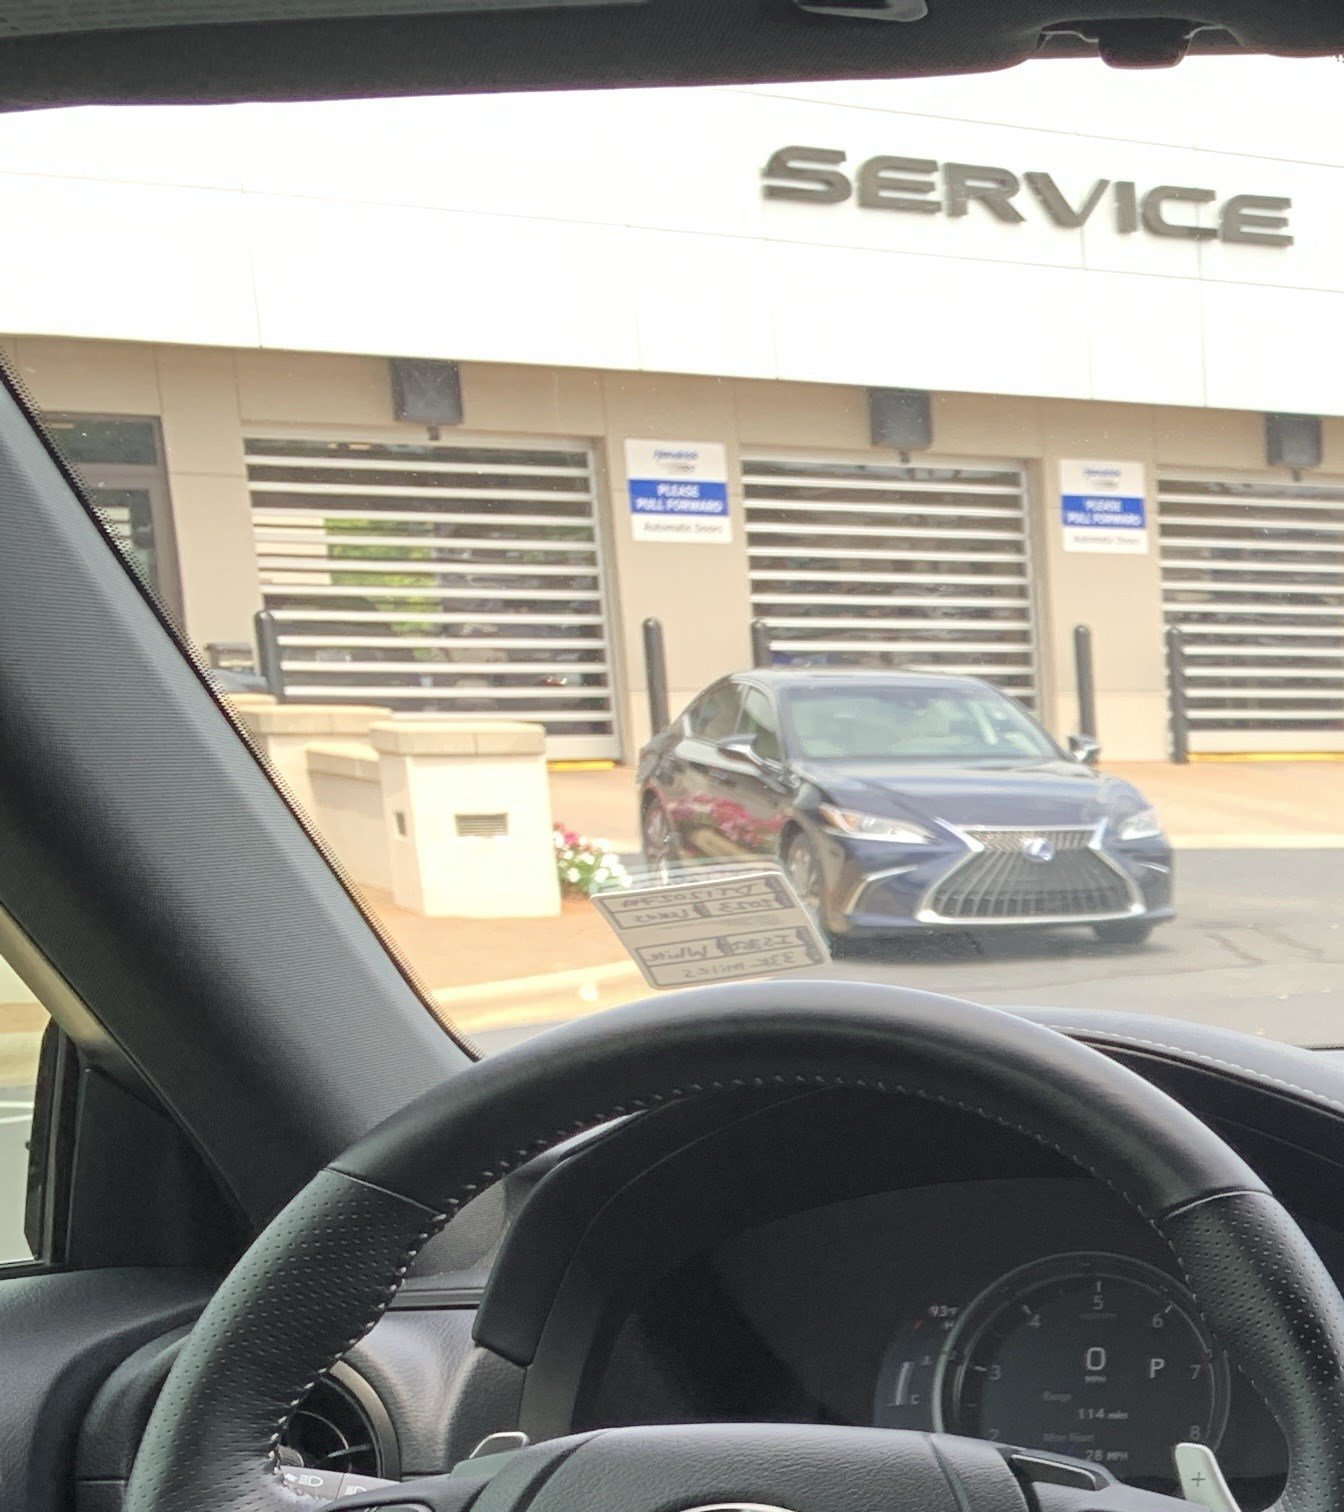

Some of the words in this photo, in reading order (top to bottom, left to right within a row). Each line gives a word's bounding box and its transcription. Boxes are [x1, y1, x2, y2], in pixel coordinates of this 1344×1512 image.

[760, 146, 1294, 246] SERVICE
[657, 484, 700, 498] PLEASE
[635, 497, 664, 511] PULL
[665, 499, 724, 513] FORWARD
[1084, 499, 1121, 512] PLEASE
[1094, 1296, 1103, 1310] 5
[1029, 1315, 1041, 1328] 4
[1153, 1315, 1163, 1328] 6
[1085, 1347, 1107, 1371] 0
[990, 1365, 1001, 1380] 3
[1150, 1358, 1165, 1379] P
[1191, 1364, 1201, 1380] 7
[1191, 1425, 1201, 1440] 8
